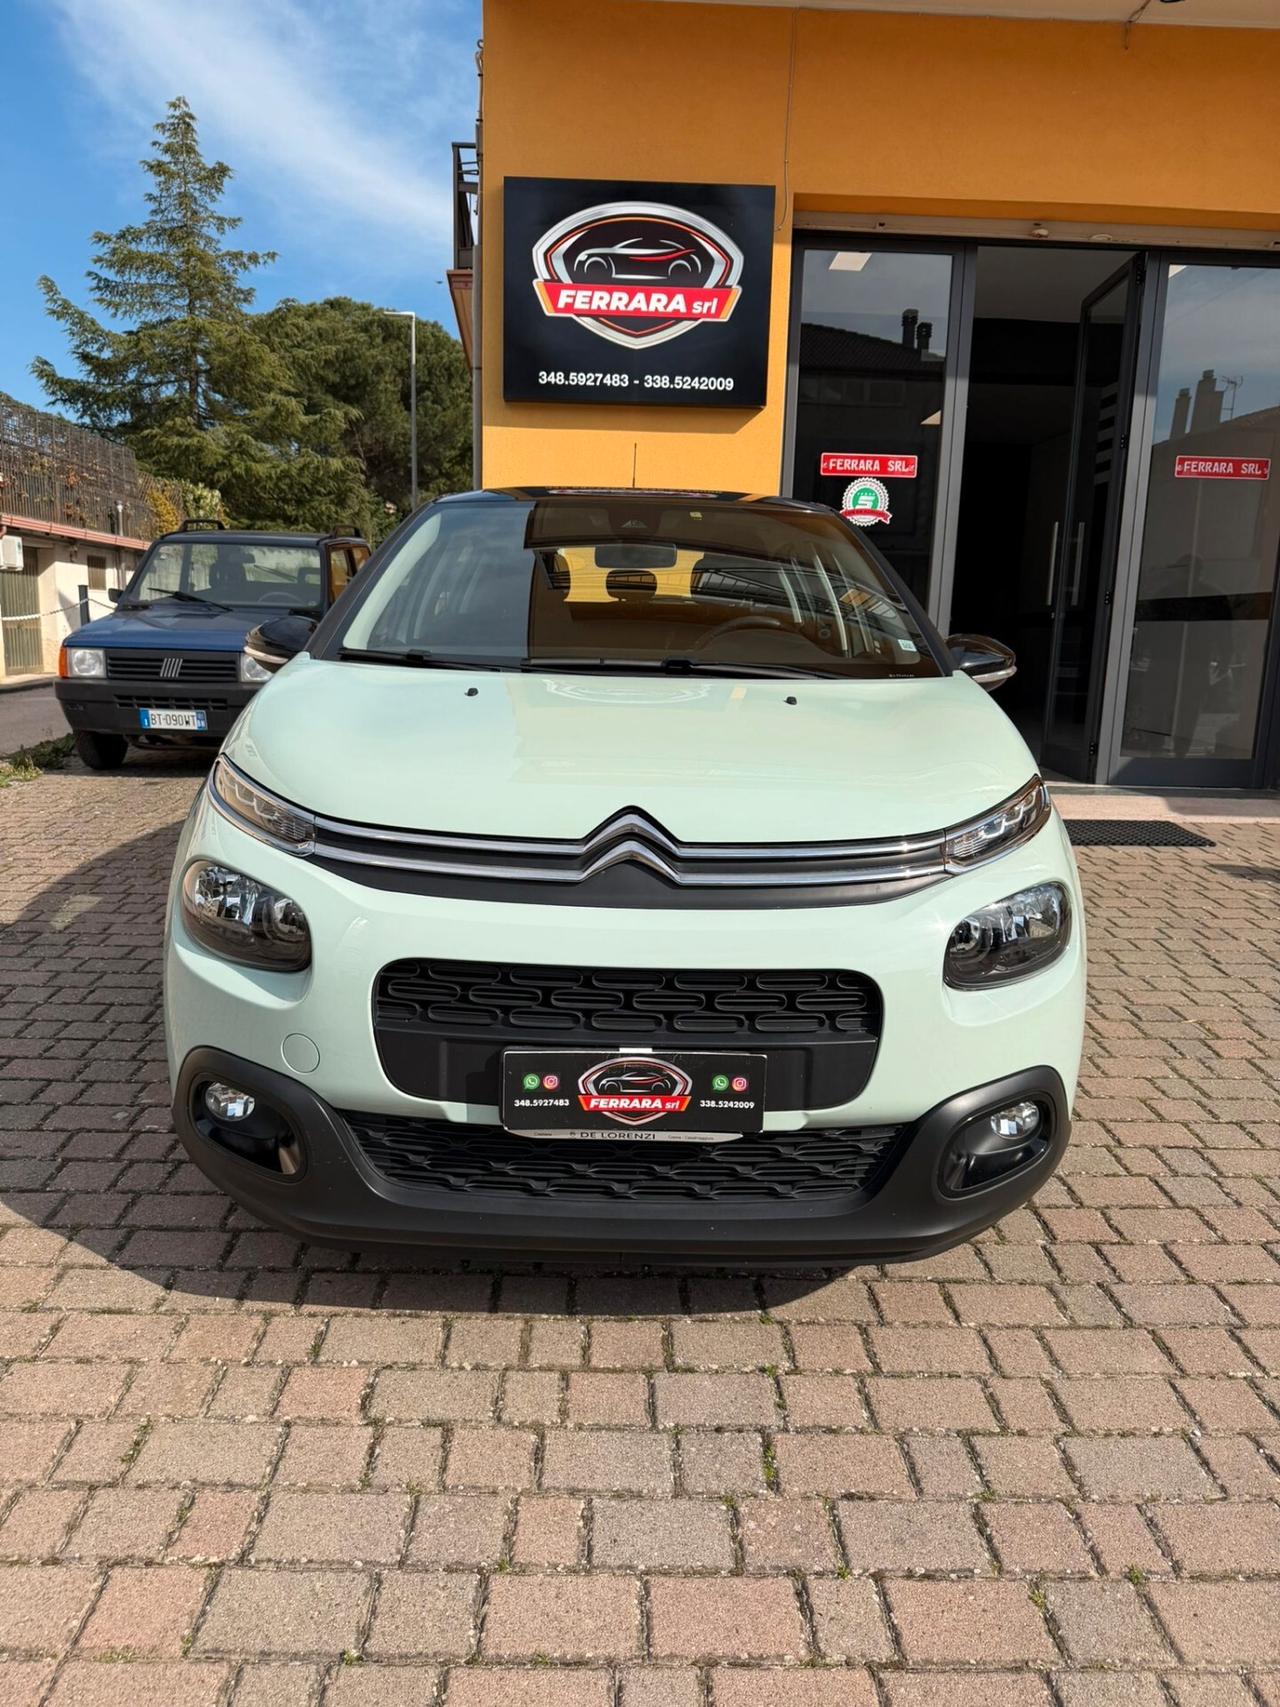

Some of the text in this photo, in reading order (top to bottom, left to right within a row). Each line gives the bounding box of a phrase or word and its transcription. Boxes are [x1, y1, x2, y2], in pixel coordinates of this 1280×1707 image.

[557, 289, 718, 315] FERRARA srl
[538, 371, 629, 387] 348.5927483
[644, 375, 734, 391] 338.5242009
[828, 458, 909, 472] FERRARA SRL
[1184, 461, 1262, 474] FERRARA SRL
[514, 1099, 570, 1108] 348.5927483
[589, 1098, 680, 1111] FERRARA srl
[700, 1100, 755, 1110] 338.5242009
[580, 1132, 656, 1141] DE LORENZI
